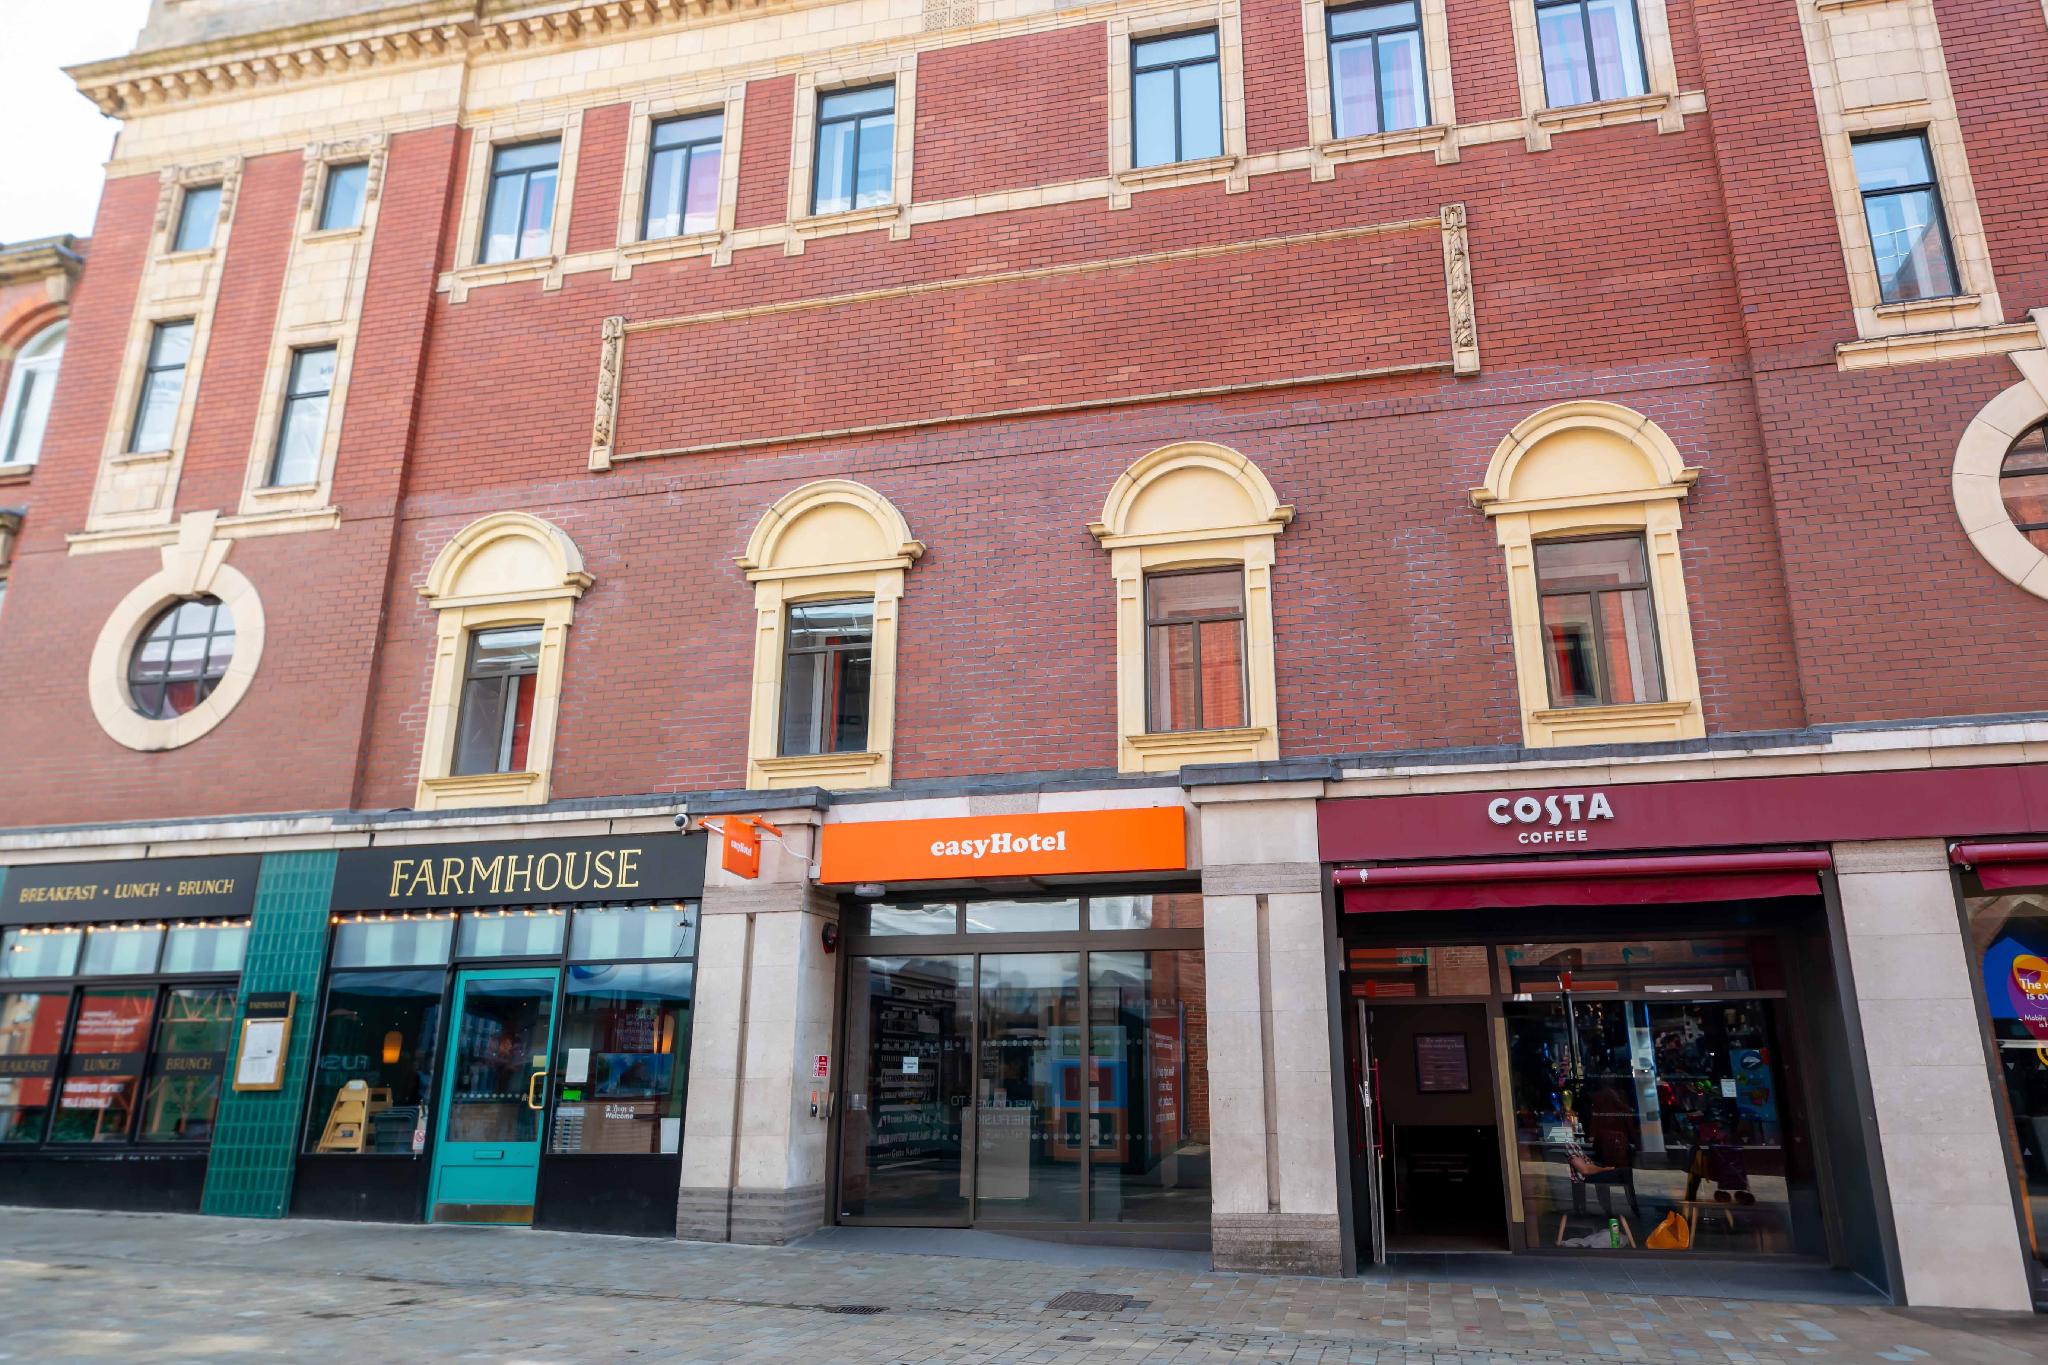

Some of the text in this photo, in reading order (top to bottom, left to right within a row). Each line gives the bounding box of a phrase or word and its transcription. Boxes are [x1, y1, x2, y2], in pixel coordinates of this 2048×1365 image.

[1487, 792, 1615, 827] COSTA
[1518, 829, 1588, 844] COFFEE
[930, 830, 1067, 859] easyHotel
[389, 848, 642, 898] FARMHOUSE
[19, 878, 235, 903] BREAKFAST LUNCH BRUNCH
[2018, 977, 2041, 990] The
[2026, 990, 2035, 1000] is
[2024, 1013, 2047, 1022] Mobile
[83, 1058, 122, 1072] LUNCH
[165, 1057, 212, 1070] BRUNCH
